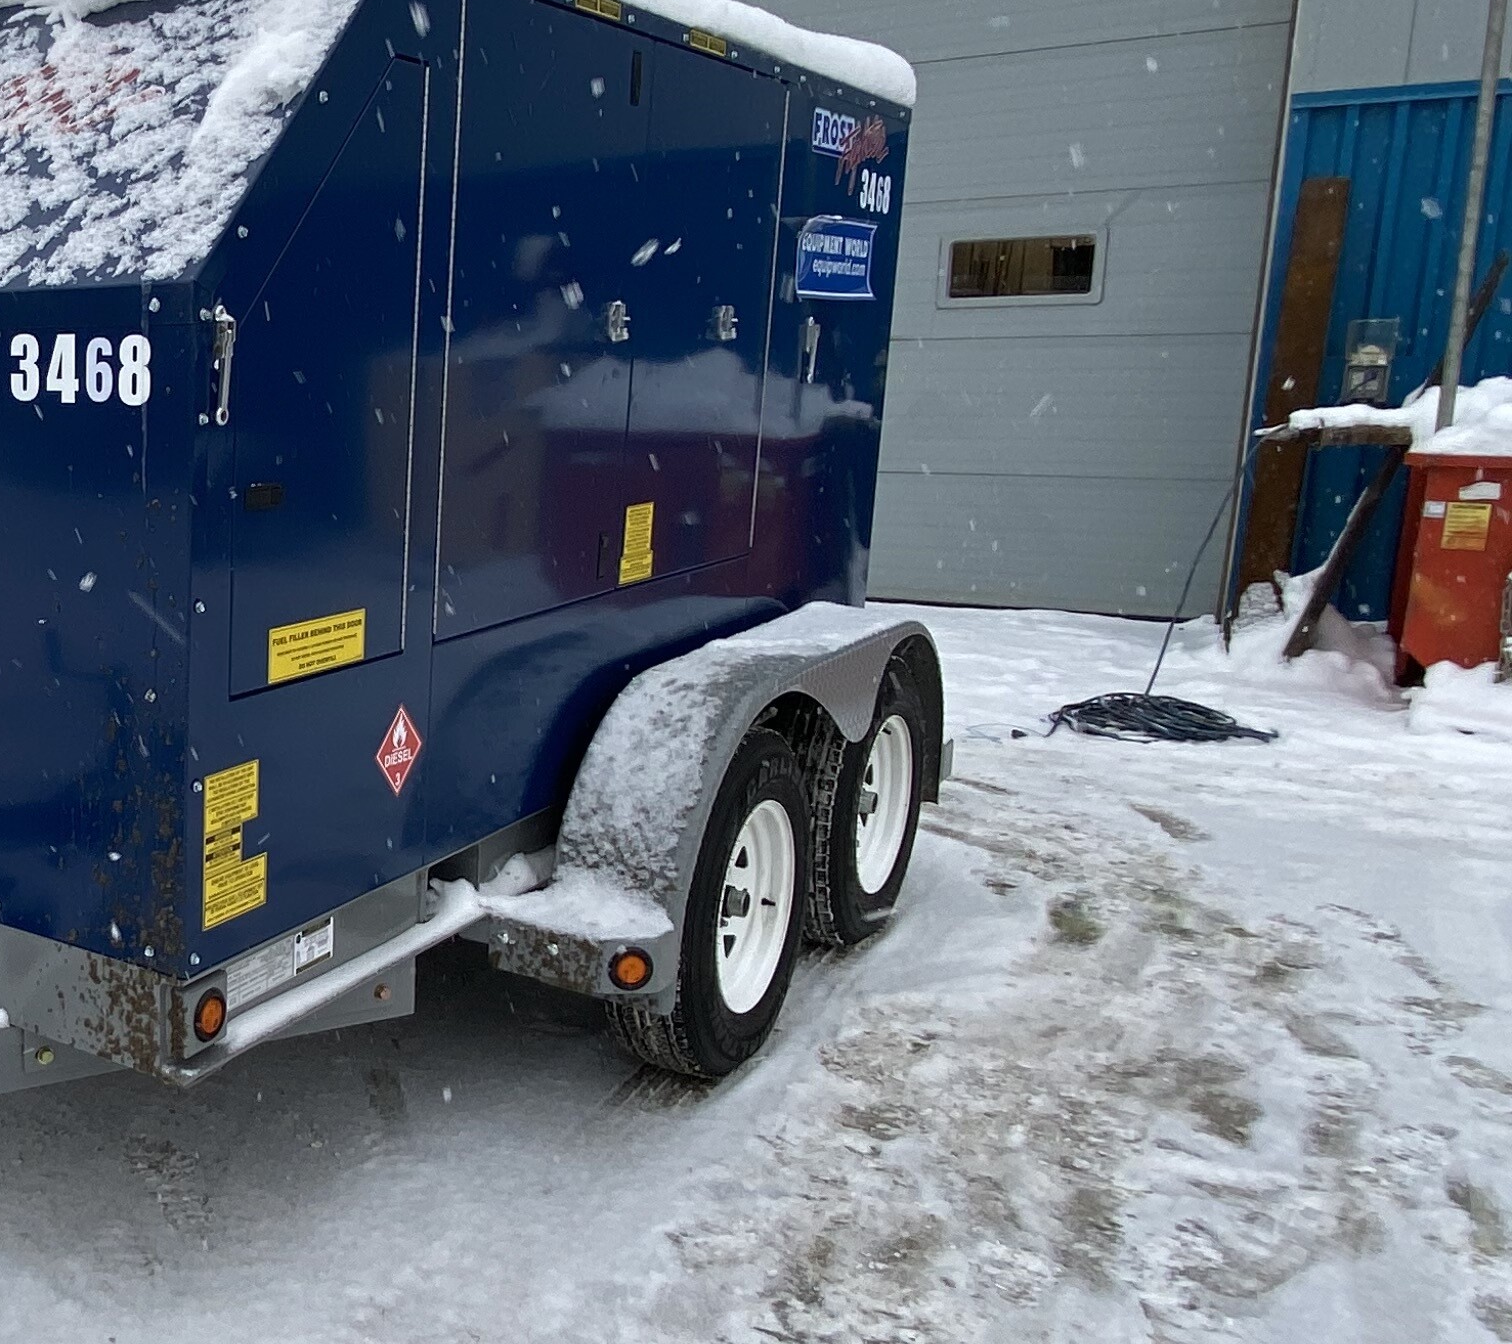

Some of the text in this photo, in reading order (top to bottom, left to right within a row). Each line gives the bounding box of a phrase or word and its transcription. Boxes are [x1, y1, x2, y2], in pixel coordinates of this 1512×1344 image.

[813, 110, 855, 150] FROST
[859, 168, 891, 214] 3468
[801, 232, 869, 258] EQUIPMENT WORLD
[812, 257, 866, 277] equipworld.com
[10, 333, 151, 406] 3468
[272, 636, 288, 647] FUEL
[289, 631, 309, 643] FILLER
[310, 625, 332, 637] BEHIND
[333, 622, 346, 632] THIS
[346, 618, 363, 629] DOOR
[384, 748, 413, 768] DIESEL
[395, 772, 401, 786] 3
